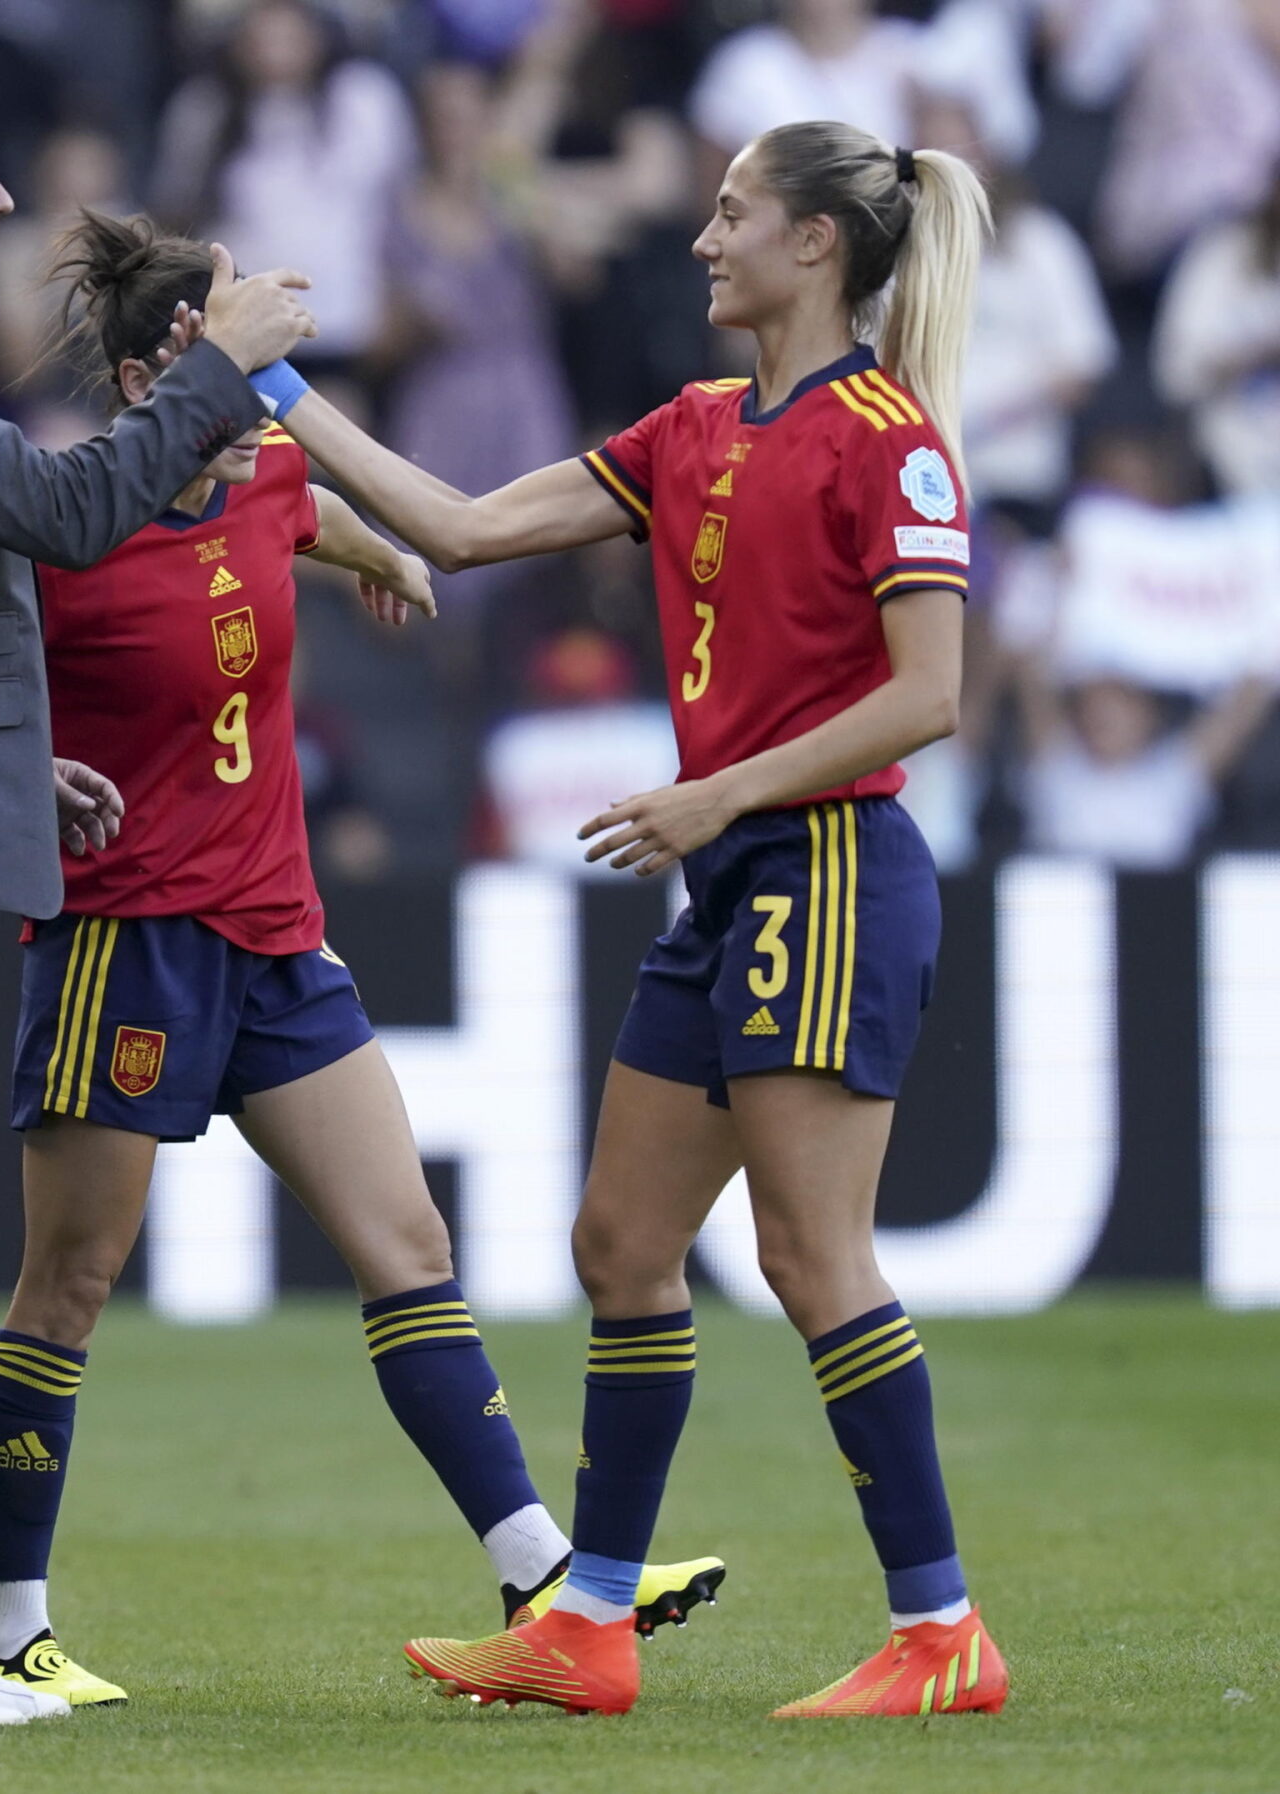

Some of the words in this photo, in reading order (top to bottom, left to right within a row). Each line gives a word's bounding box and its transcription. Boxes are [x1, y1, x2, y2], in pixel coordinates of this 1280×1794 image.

[209, 579, 242, 597] adidas
[682, 601, 715, 702] 3
[212, 692, 253, 784] 9
[748, 895, 792, 999] 3
